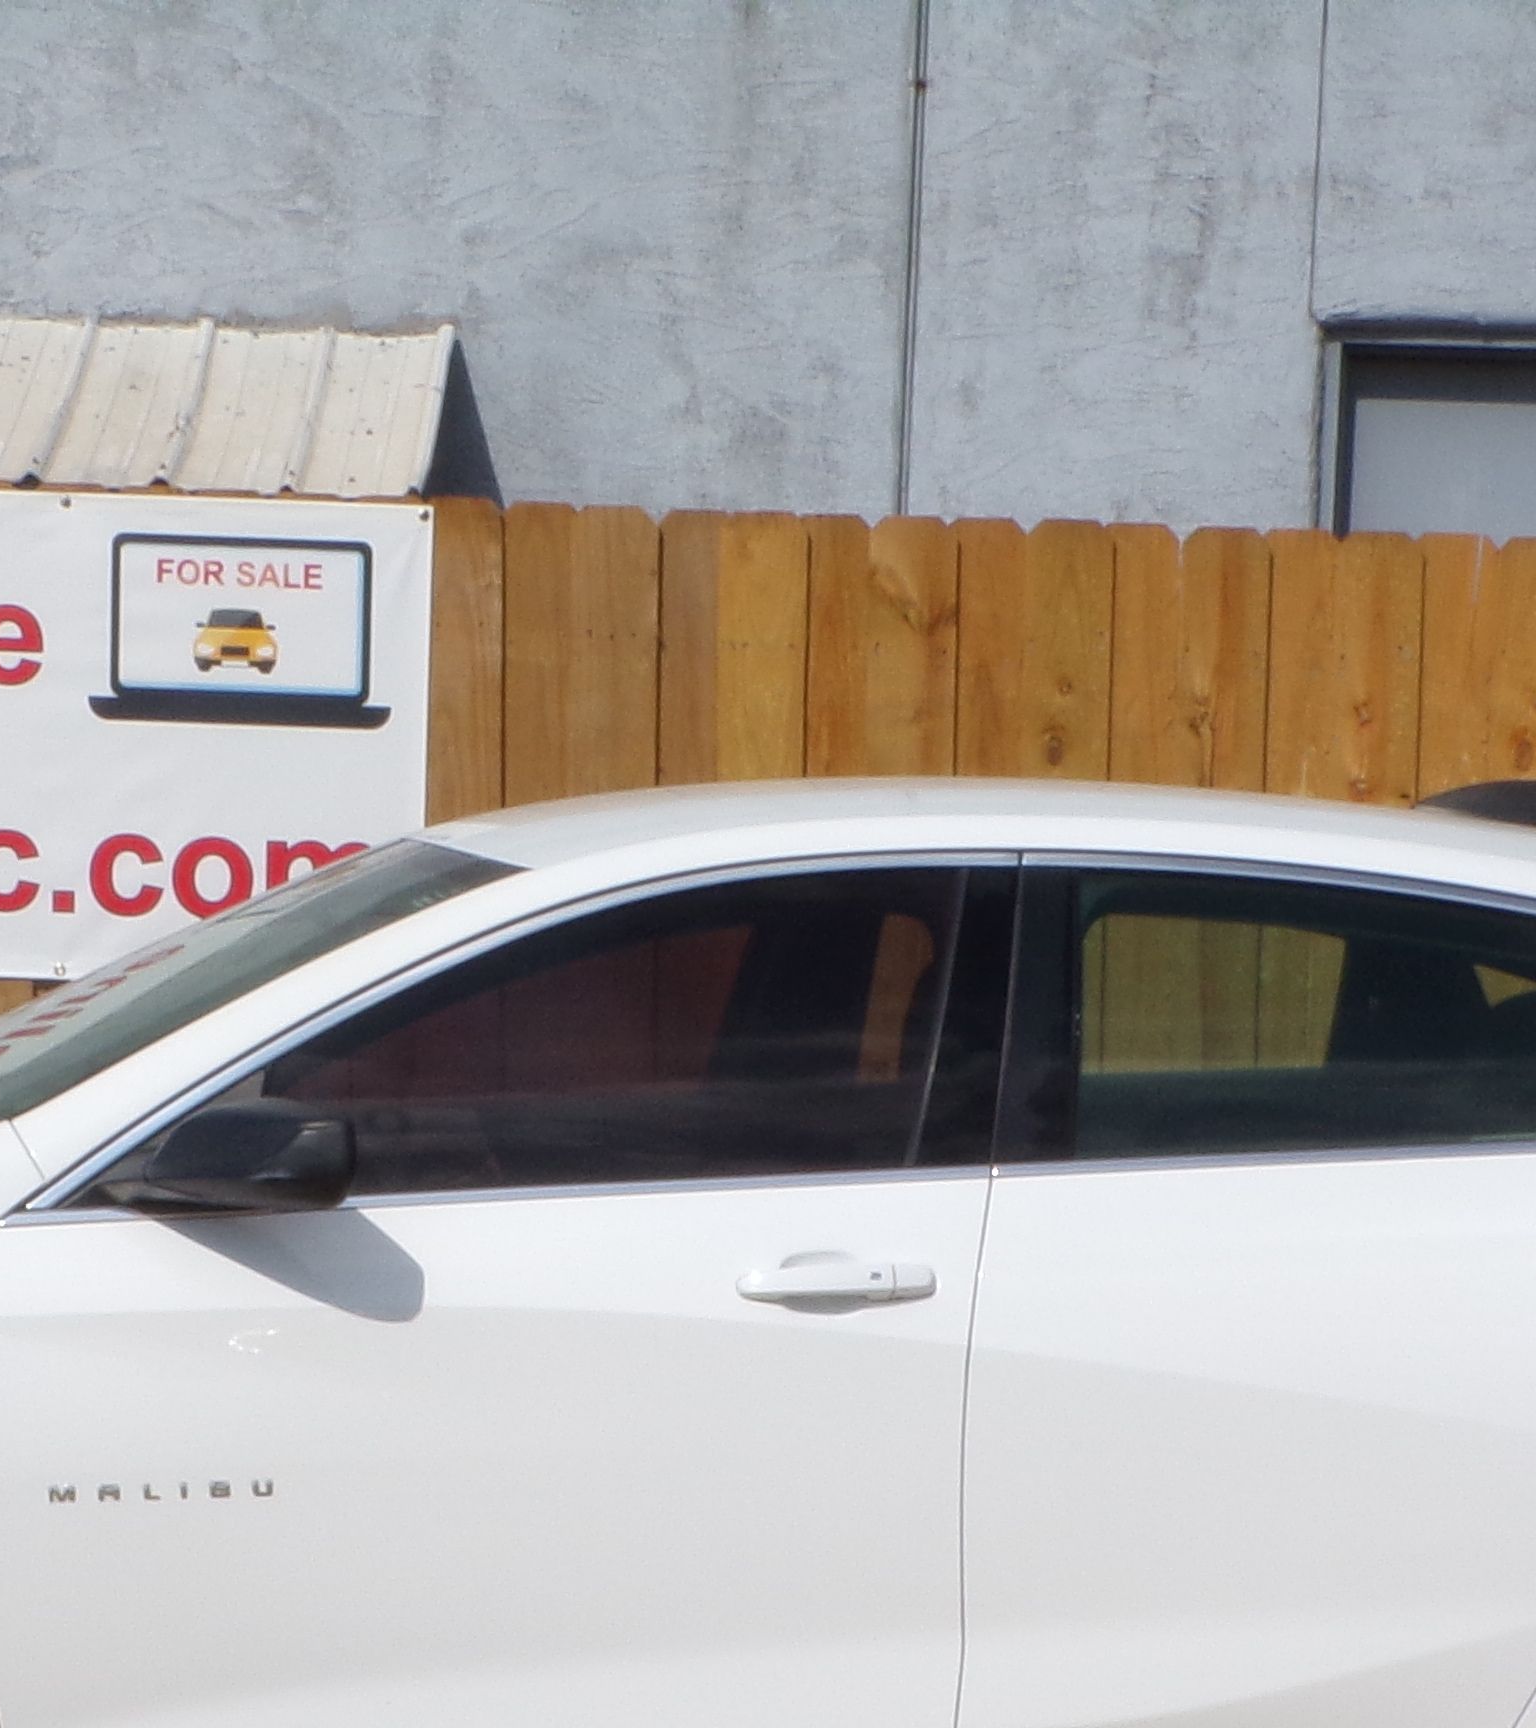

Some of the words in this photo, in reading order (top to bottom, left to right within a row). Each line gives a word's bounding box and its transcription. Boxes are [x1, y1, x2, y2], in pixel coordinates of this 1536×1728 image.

[156, 558, 224, 586] FOR
[236, 561, 323, 590] SALE
[48, 1479, 274, 1503] MALIBU
